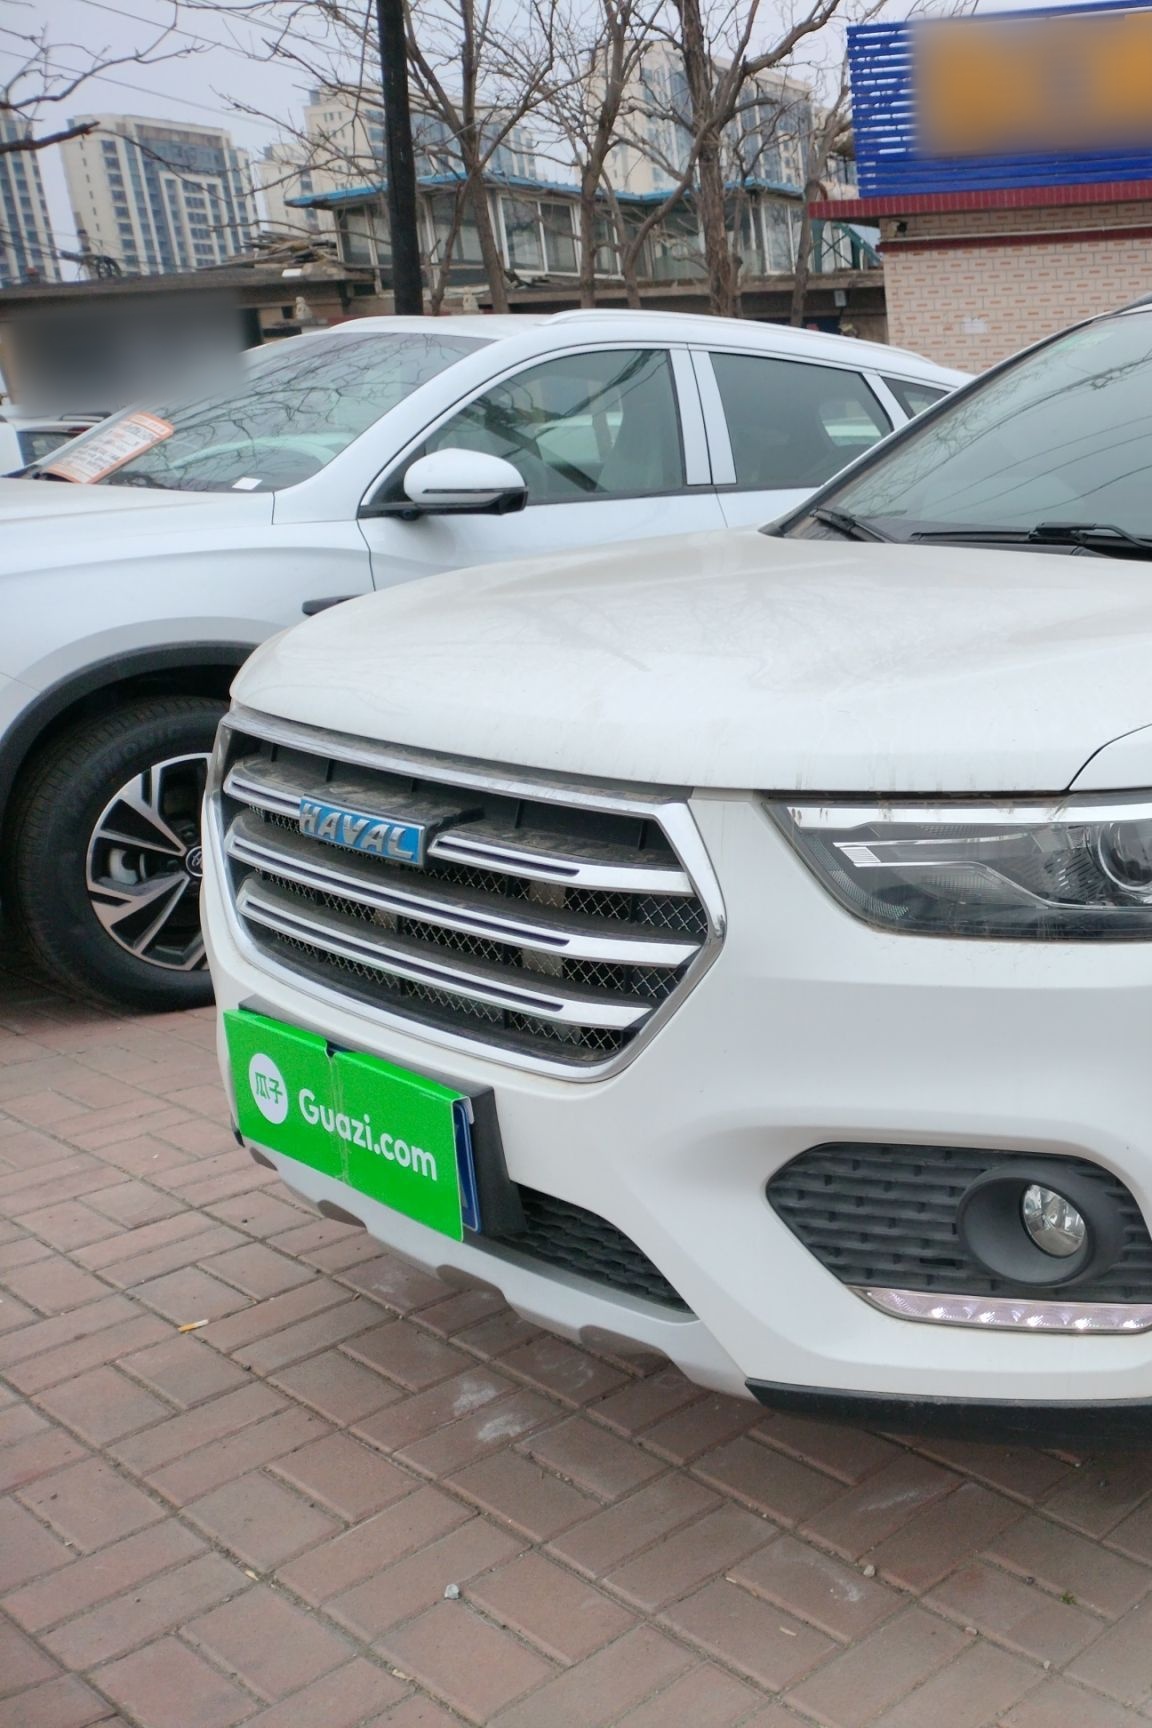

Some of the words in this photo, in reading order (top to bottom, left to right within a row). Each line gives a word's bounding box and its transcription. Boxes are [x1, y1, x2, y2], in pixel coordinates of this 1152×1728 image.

[300, 802, 414, 859] HAVAL
[254, 1071, 283, 1105] 瓜子
[298, 1088, 438, 1182] Guazi.com
